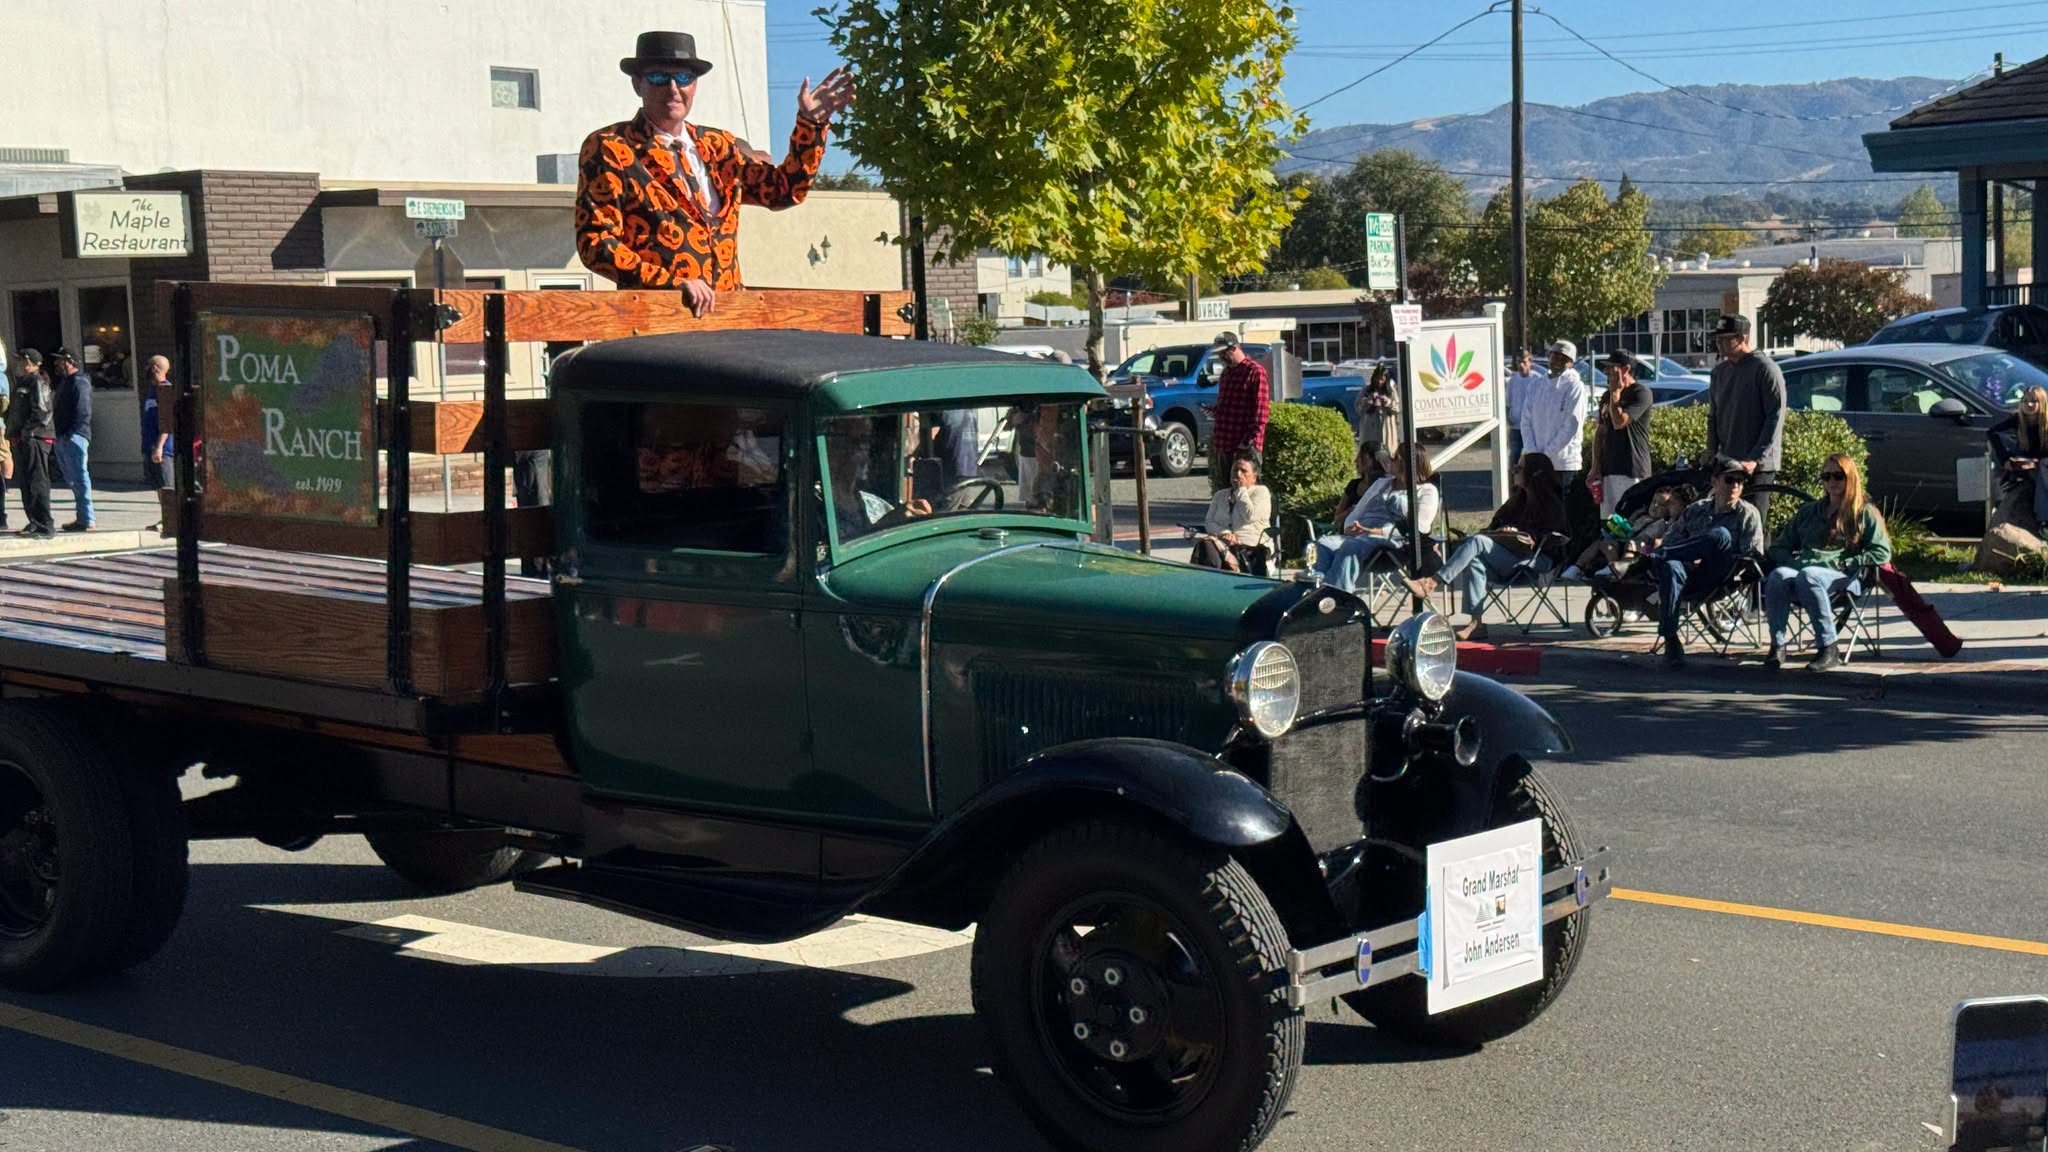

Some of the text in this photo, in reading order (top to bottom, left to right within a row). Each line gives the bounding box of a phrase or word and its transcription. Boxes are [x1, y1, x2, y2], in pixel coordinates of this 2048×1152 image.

[132, 199, 154, 211] The
[110, 210, 171, 233] Maple
[82, 232, 189, 251] Restaurant
[1415, 393, 1489, 411] COMMUNITY CARE
[1463, 864, 1520, 897] Grand Marshal
[1464, 933, 1520, 963] John Andersen
